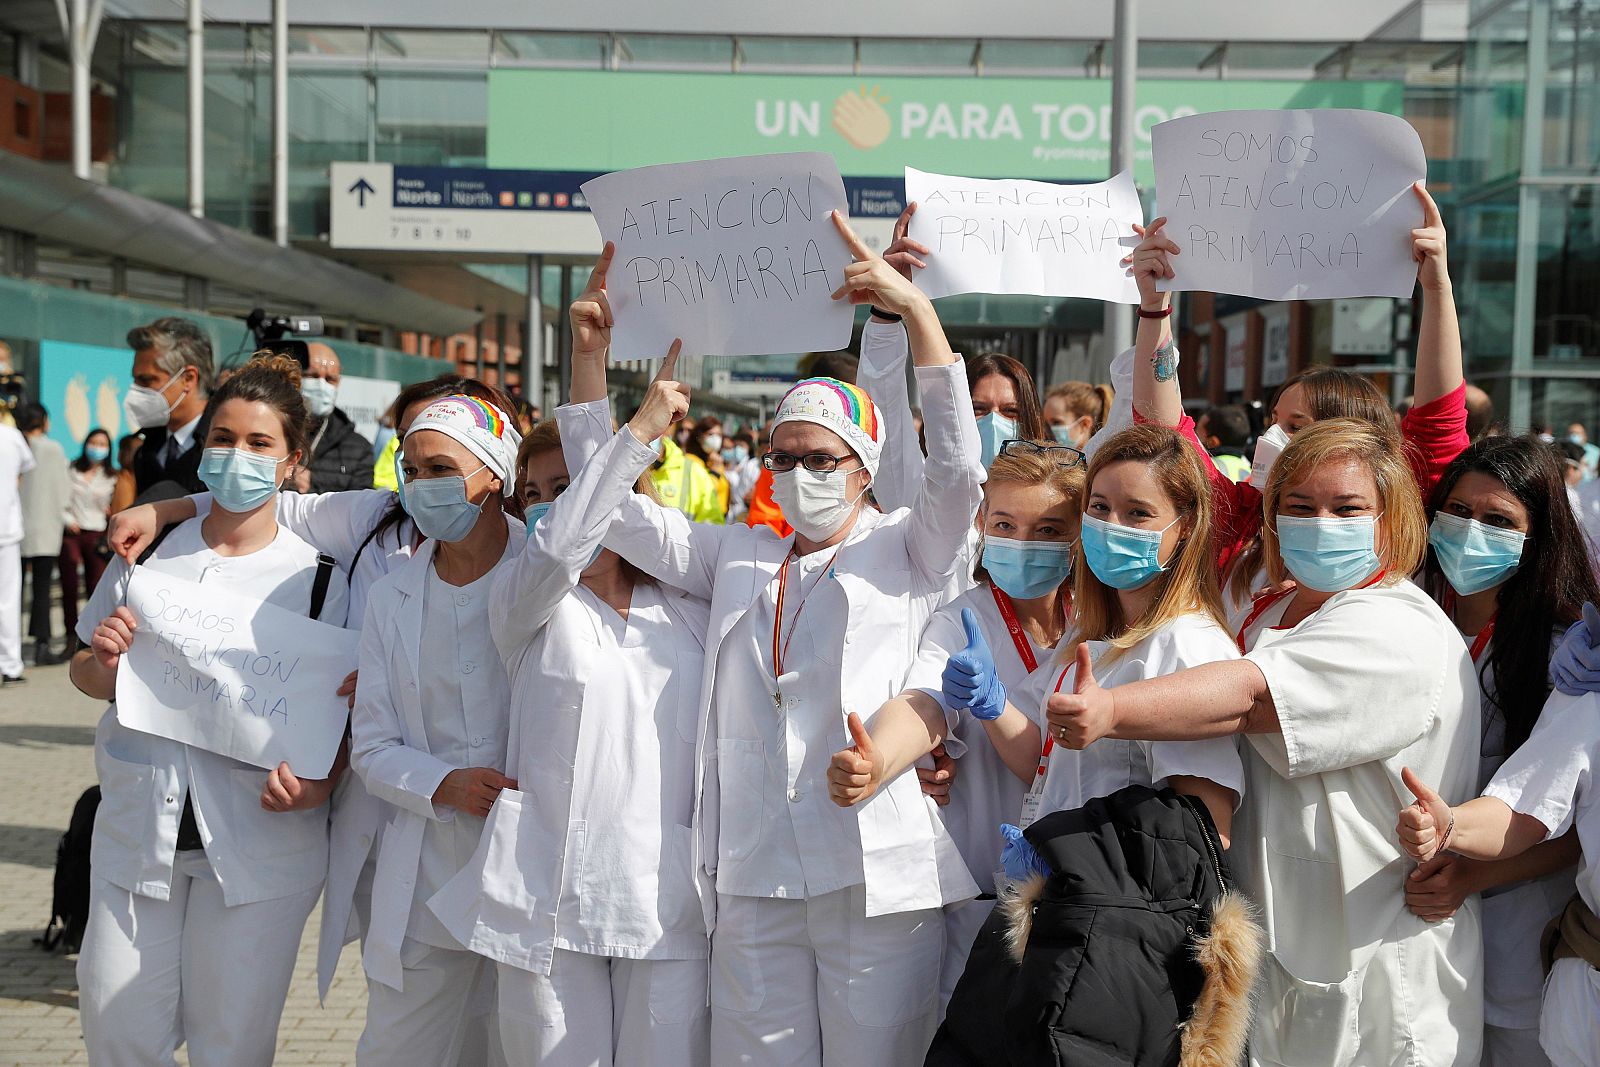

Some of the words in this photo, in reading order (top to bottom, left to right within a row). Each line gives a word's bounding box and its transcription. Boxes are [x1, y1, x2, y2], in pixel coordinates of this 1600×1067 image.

[755, 100, 819, 137] UN
[901, 102, 1024, 140] PARA
[1198, 129, 1319, 163] SOMOS
[397, 190, 442, 205] Norte
[452, 191, 494, 206] North
[925, 188, 1112, 209] ATENCIÓN
[861, 199, 902, 215] North
[456, 229, 472, 241] 10
[154, 630, 301, 683] ATENCIÓN
